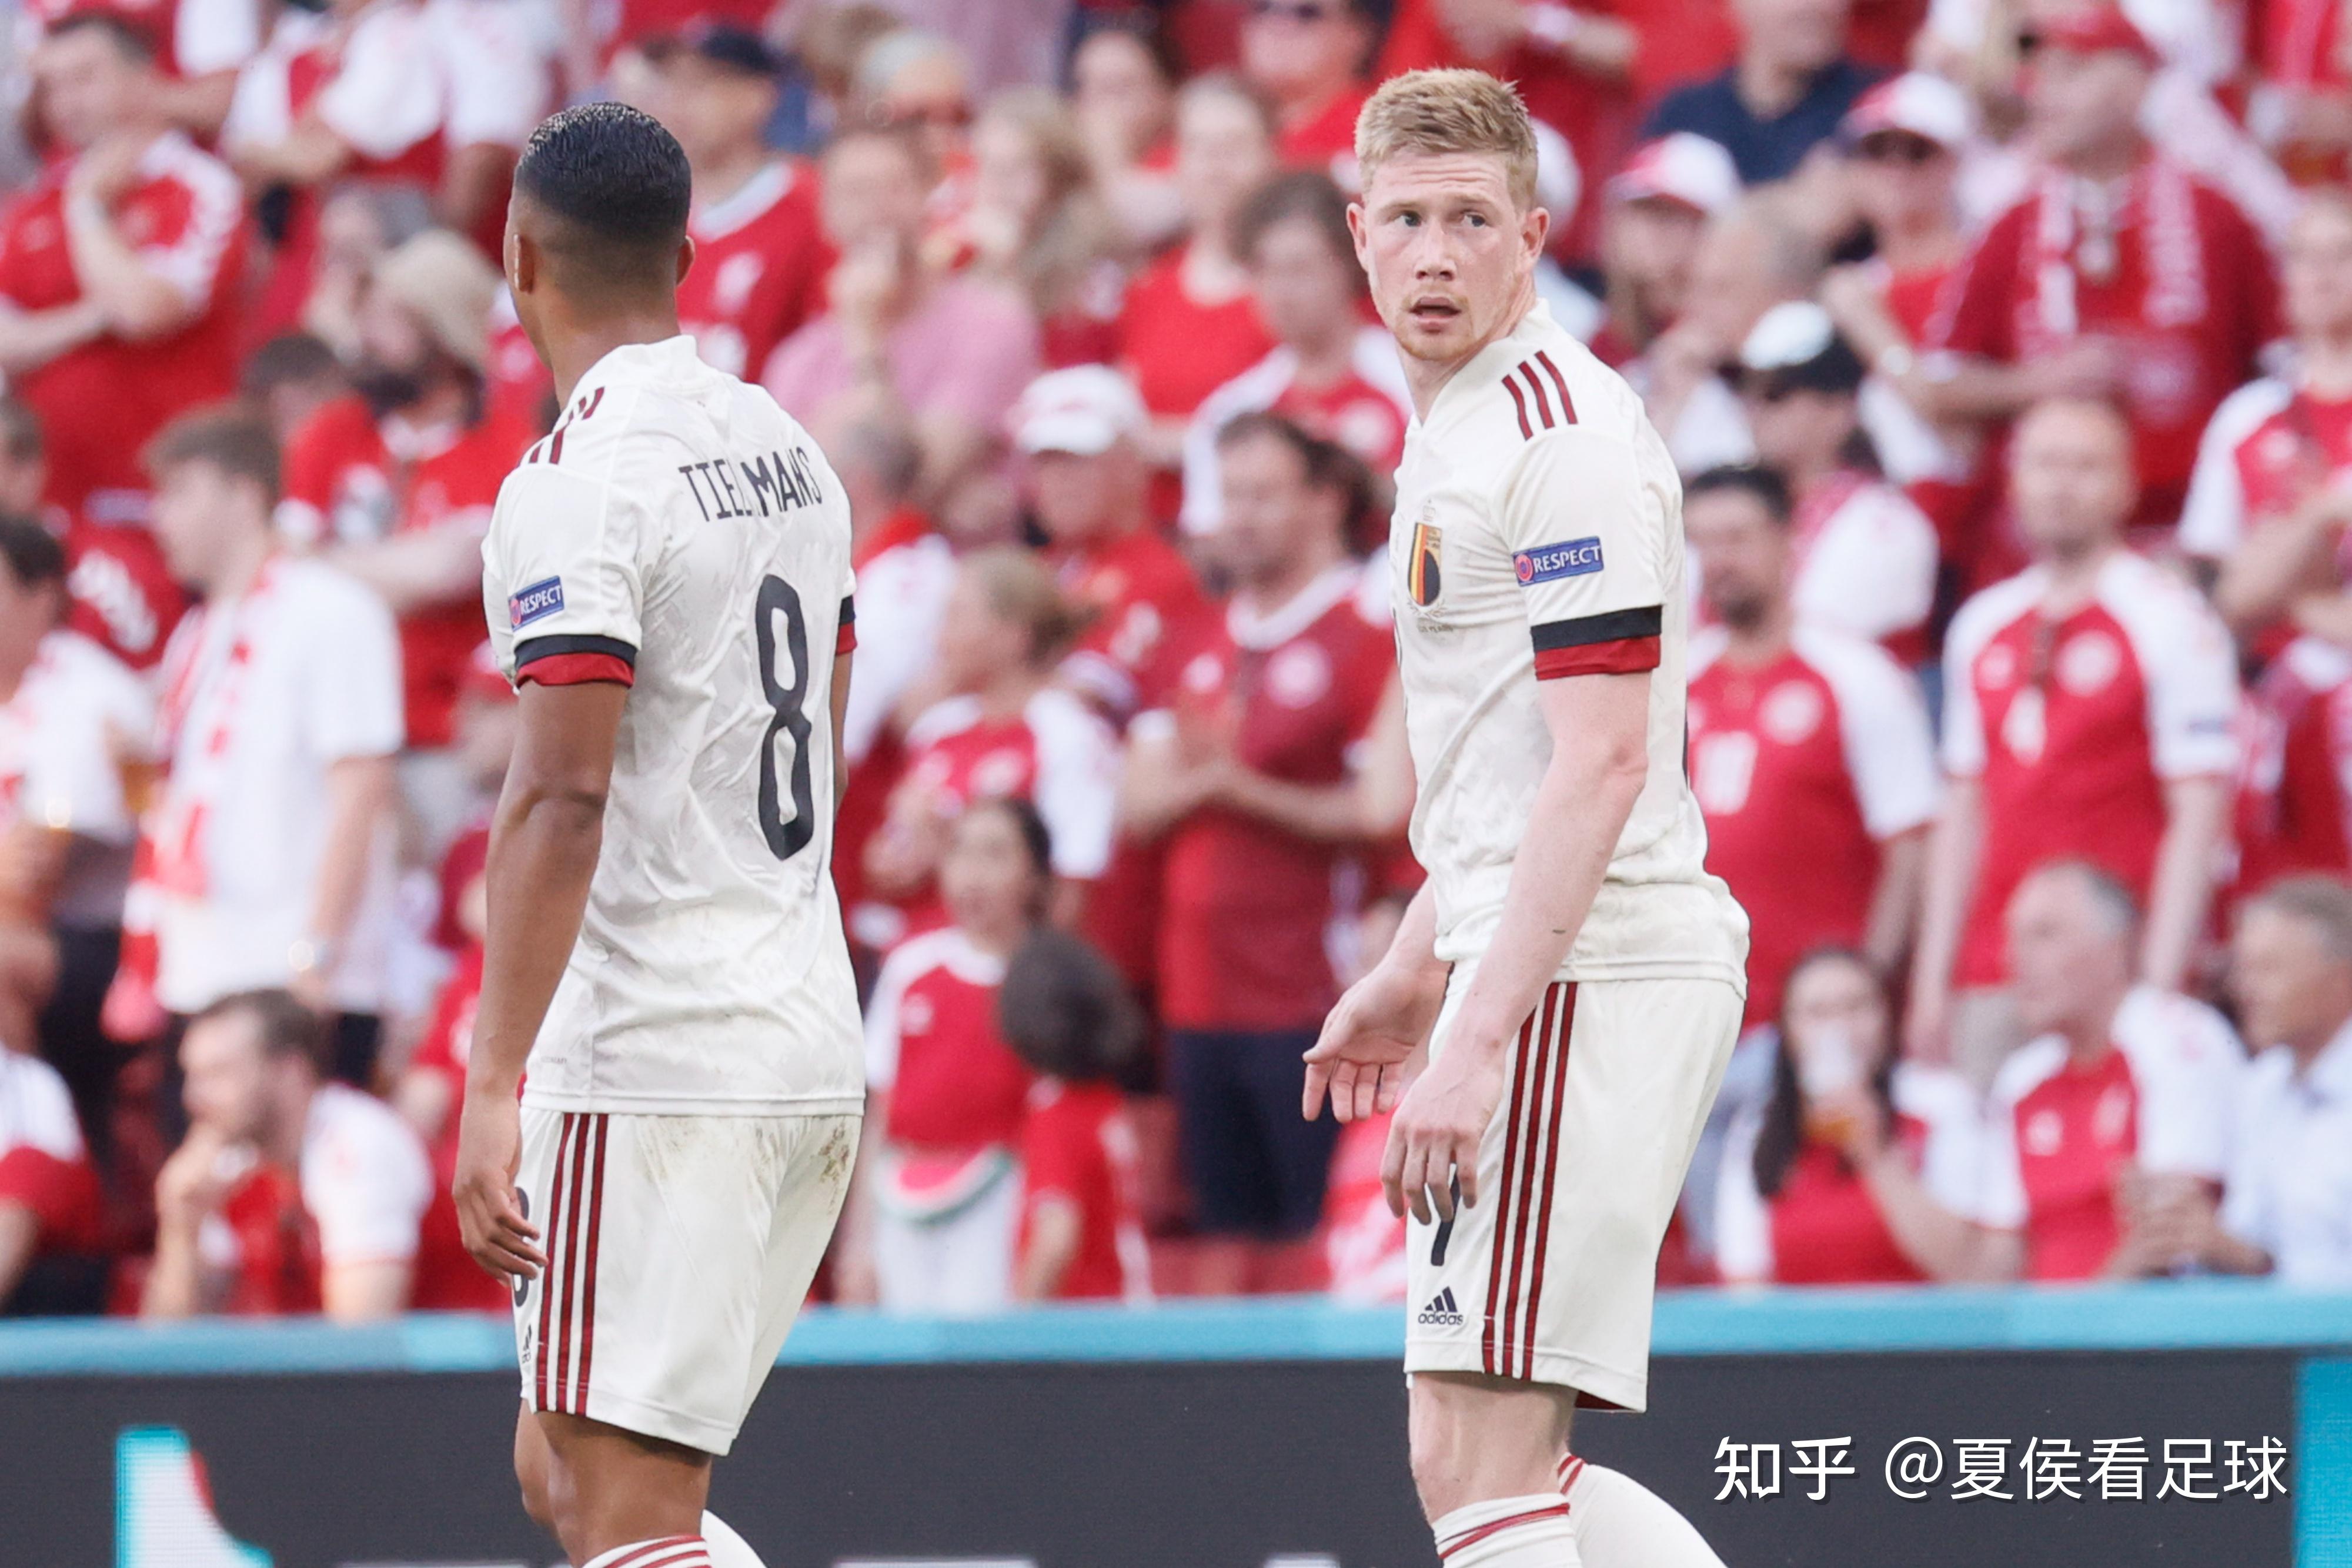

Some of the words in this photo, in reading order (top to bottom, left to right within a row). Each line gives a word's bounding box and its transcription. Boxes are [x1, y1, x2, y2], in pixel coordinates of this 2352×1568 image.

[678, 447, 822, 522] TIELMANS
[1533, 546, 1600, 573] RESPECT
[520, 585, 561, 615] RESPECT
[756, 574, 814, 861] 8
[1418, 1313, 1463, 1325] adidas
